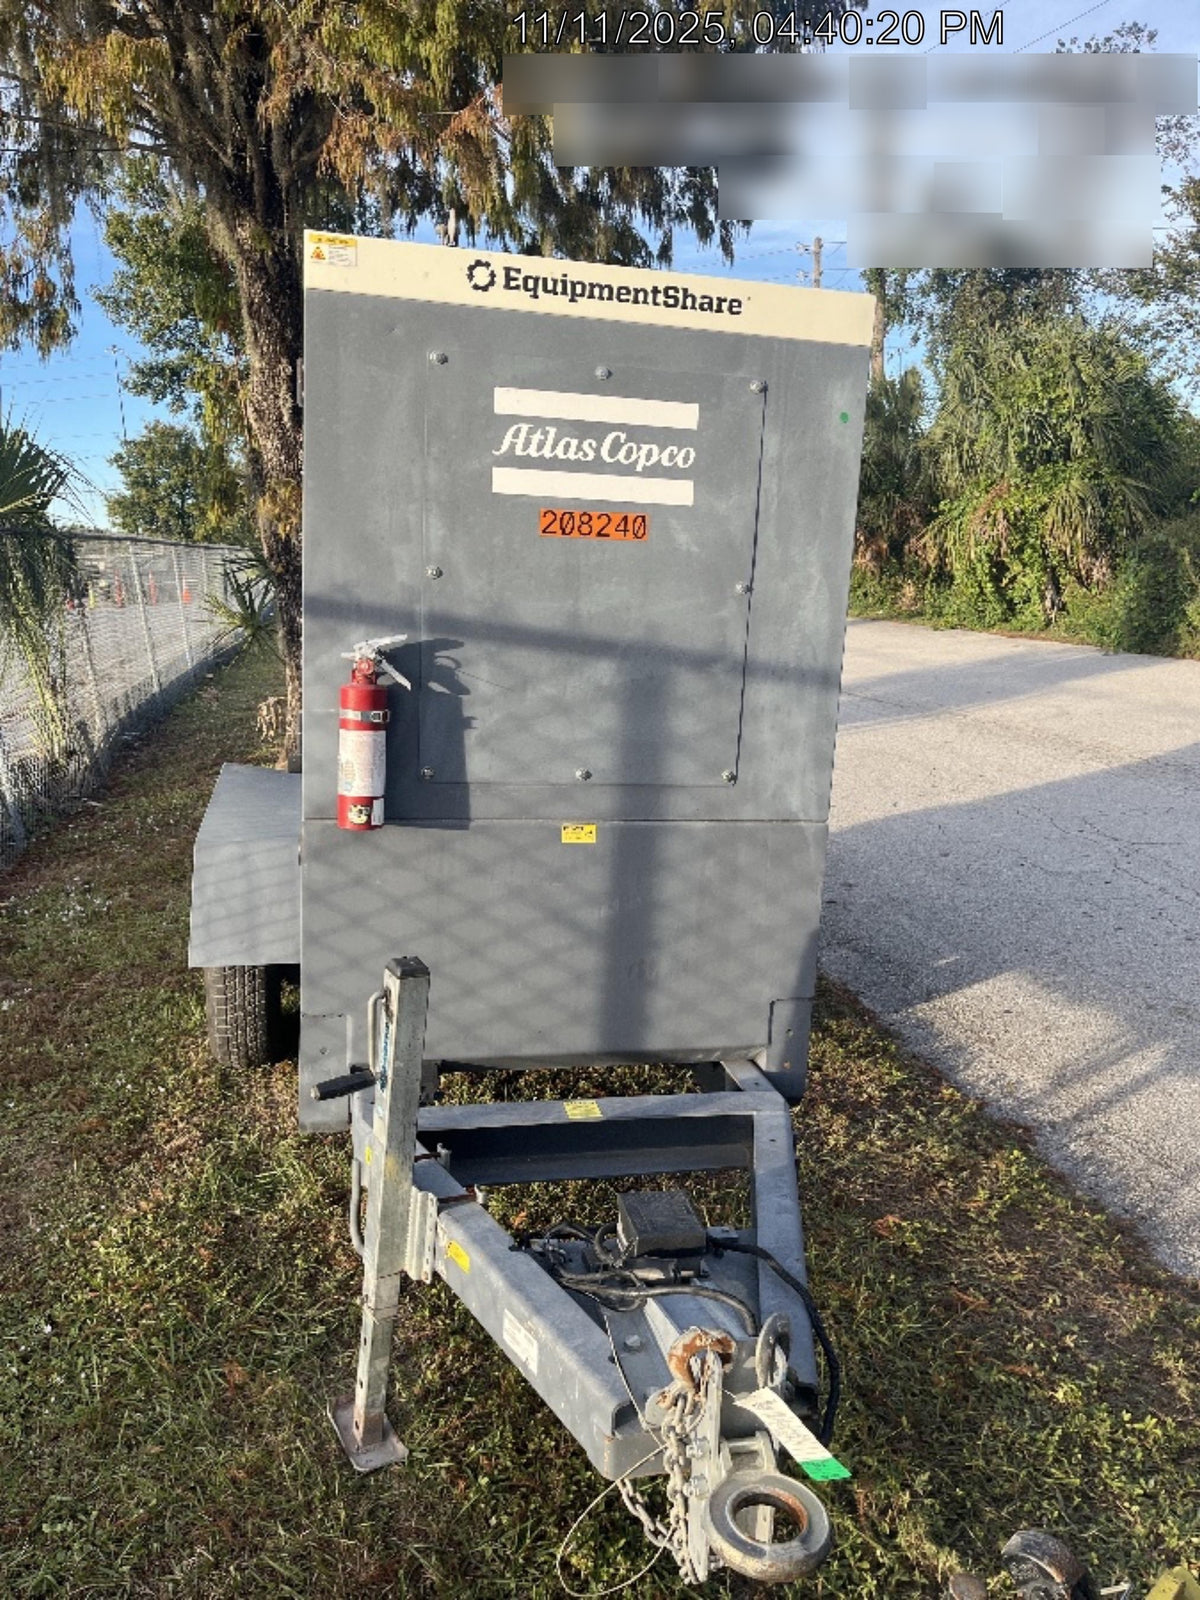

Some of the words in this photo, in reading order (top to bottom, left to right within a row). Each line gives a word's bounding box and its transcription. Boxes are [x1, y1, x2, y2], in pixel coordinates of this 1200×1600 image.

[505, 267, 742, 315] EquipmentShare
[492, 422, 596, 461] Atlas
[600, 431, 695, 471] Copco
[541, 509, 647, 540] 208240
